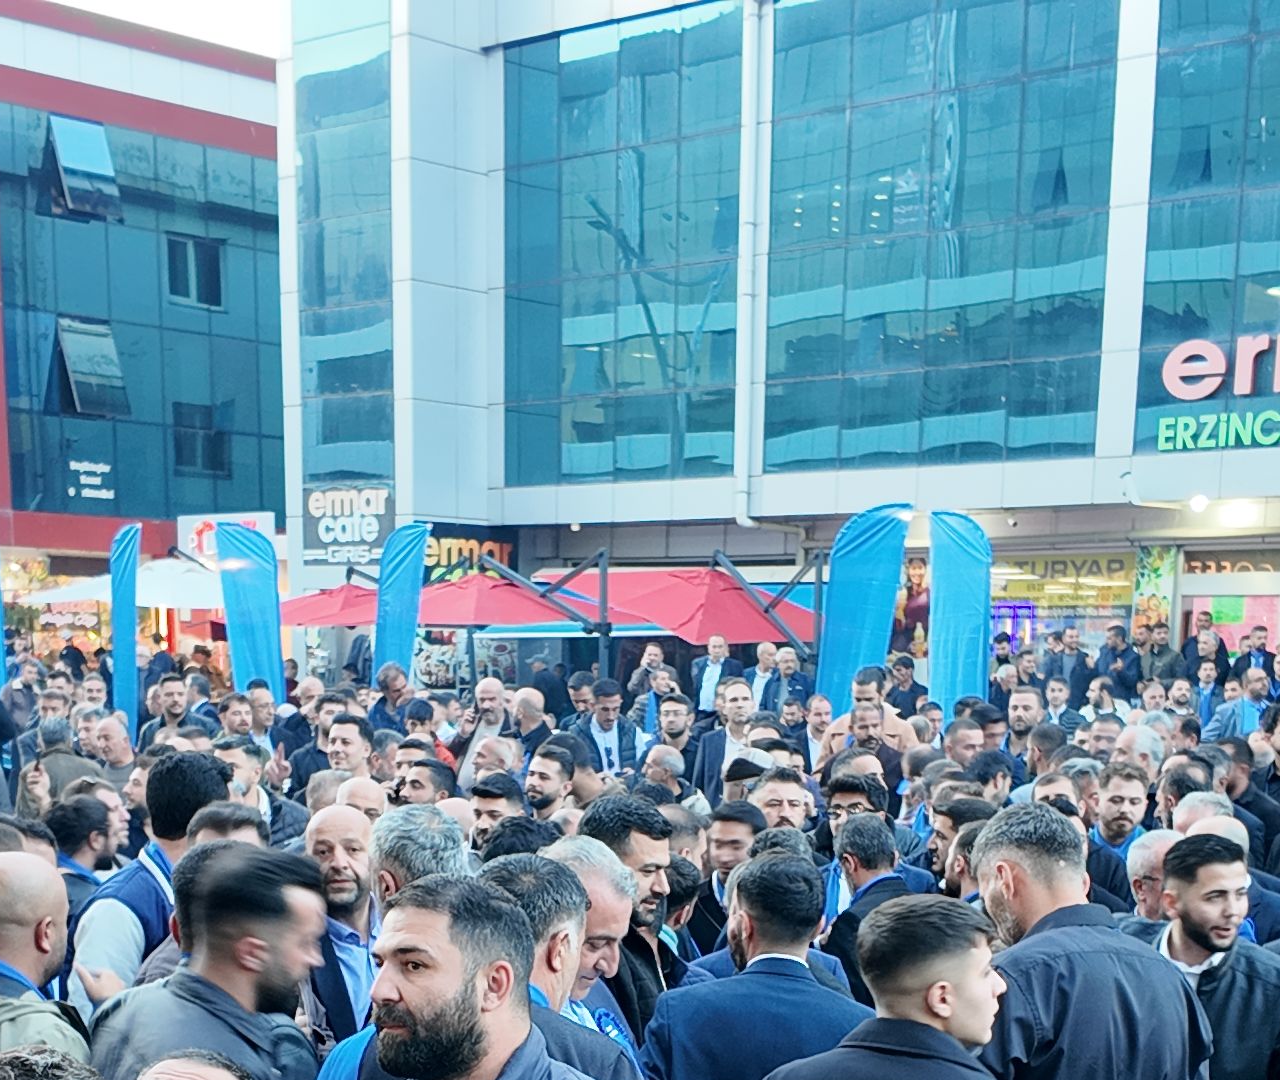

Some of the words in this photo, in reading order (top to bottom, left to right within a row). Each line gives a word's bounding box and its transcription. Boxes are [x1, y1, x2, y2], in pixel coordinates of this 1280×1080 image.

[308, 489, 389, 518] ermar
[317, 512, 380, 543] cafe
[423, 536, 513, 570] ermar
